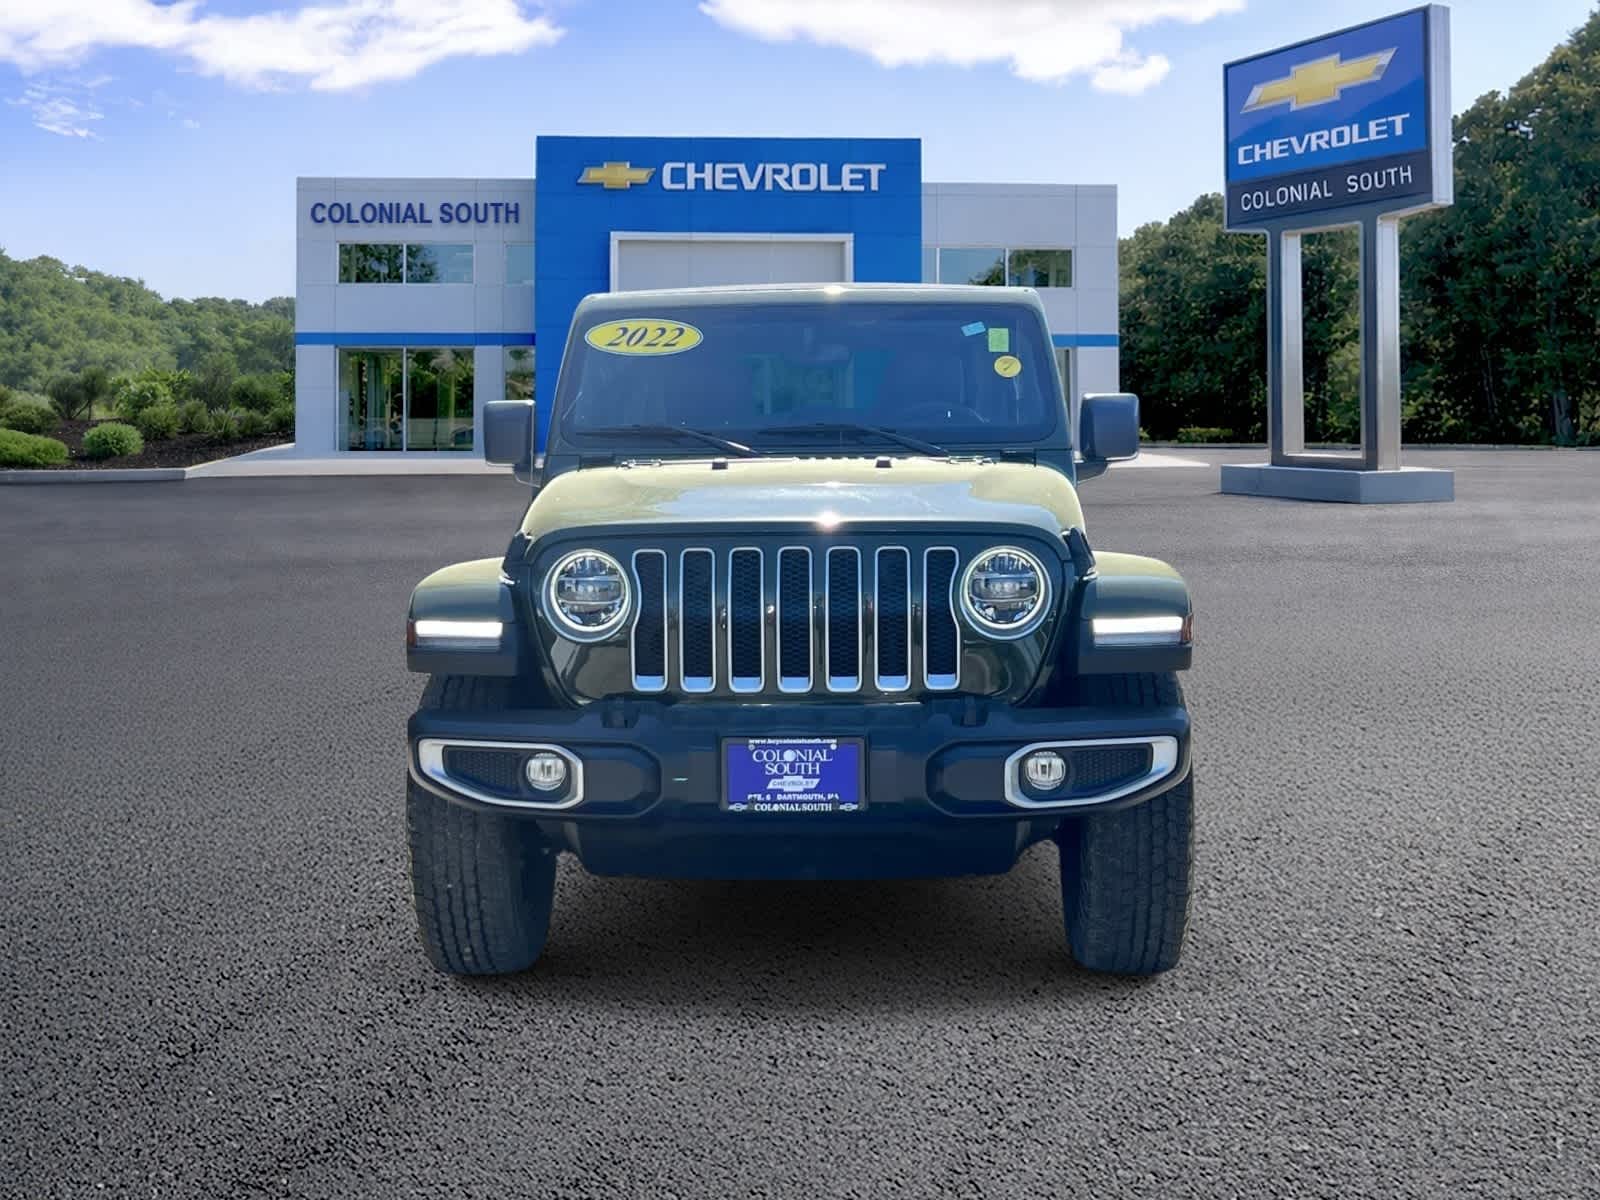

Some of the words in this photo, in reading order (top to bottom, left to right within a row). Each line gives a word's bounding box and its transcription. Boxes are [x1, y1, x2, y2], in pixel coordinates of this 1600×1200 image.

[1237, 113, 1410, 165] CHEVROLET
[662, 161, 887, 192] CHEVROLET
[1240, 179, 1333, 211] COLONIAL
[1346, 165, 1413, 193] SOUTH
[310, 202, 433, 225] COLONIAL
[439, 202, 521, 225] SOUTH
[604, 326, 686, 348] 2022
[752, 749, 833, 762] COLONIAL
[764, 762, 821, 775] SOUTH
[753, 802, 800, 812] COLONIAL
[800, 802, 832, 812] SOUTH
